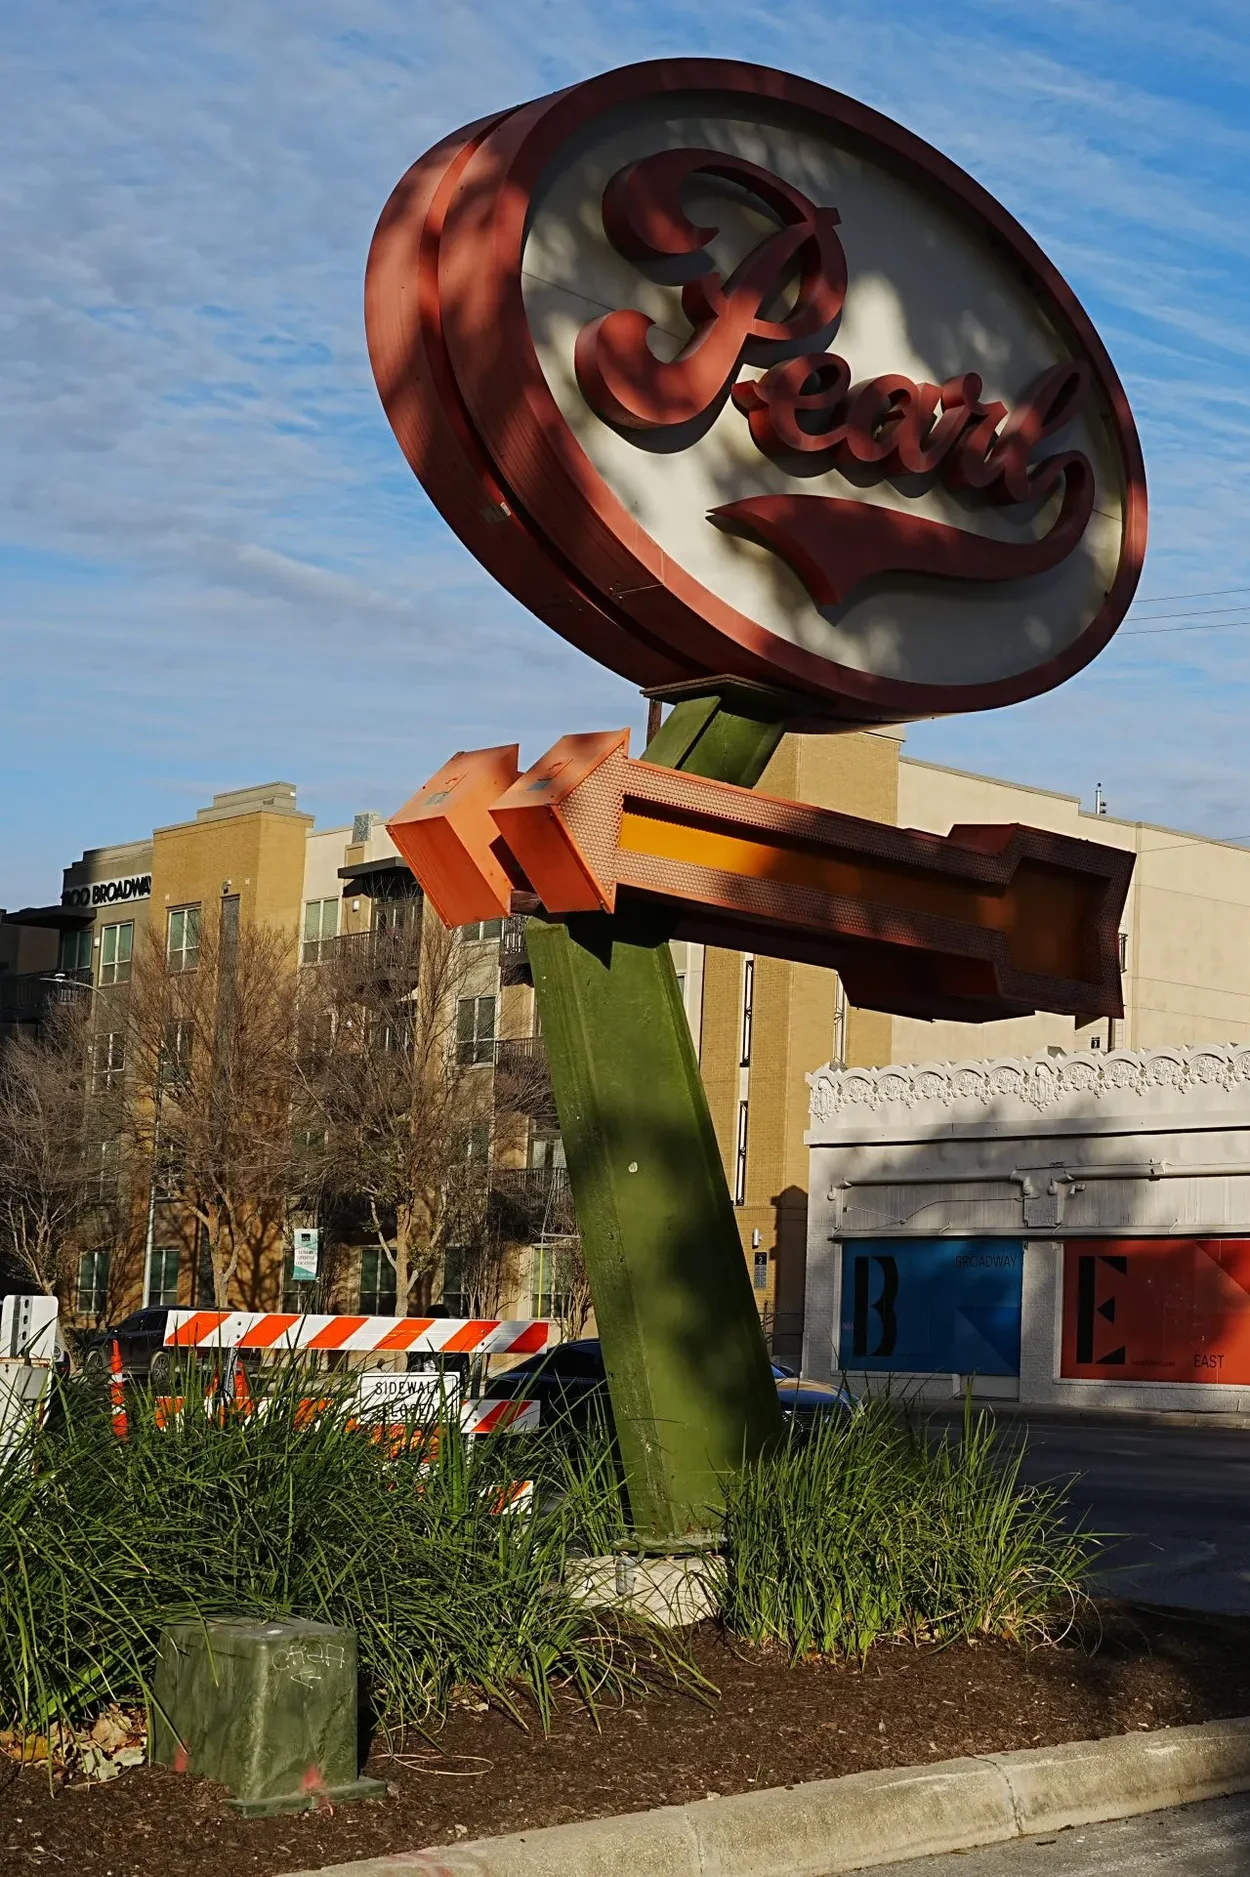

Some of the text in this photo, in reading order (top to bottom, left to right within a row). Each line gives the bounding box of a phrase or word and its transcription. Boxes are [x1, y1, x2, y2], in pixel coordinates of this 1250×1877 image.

[573, 147, 1096, 606] Pearl
[955, 1255, 1017, 1268] BROADWAY
[853, 1256, 899, 1356] B
[1076, 1256, 1127, 1364] E
[1194, 1355, 1224, 1368] EAST
[386, 1403, 436, 1417] LOED
